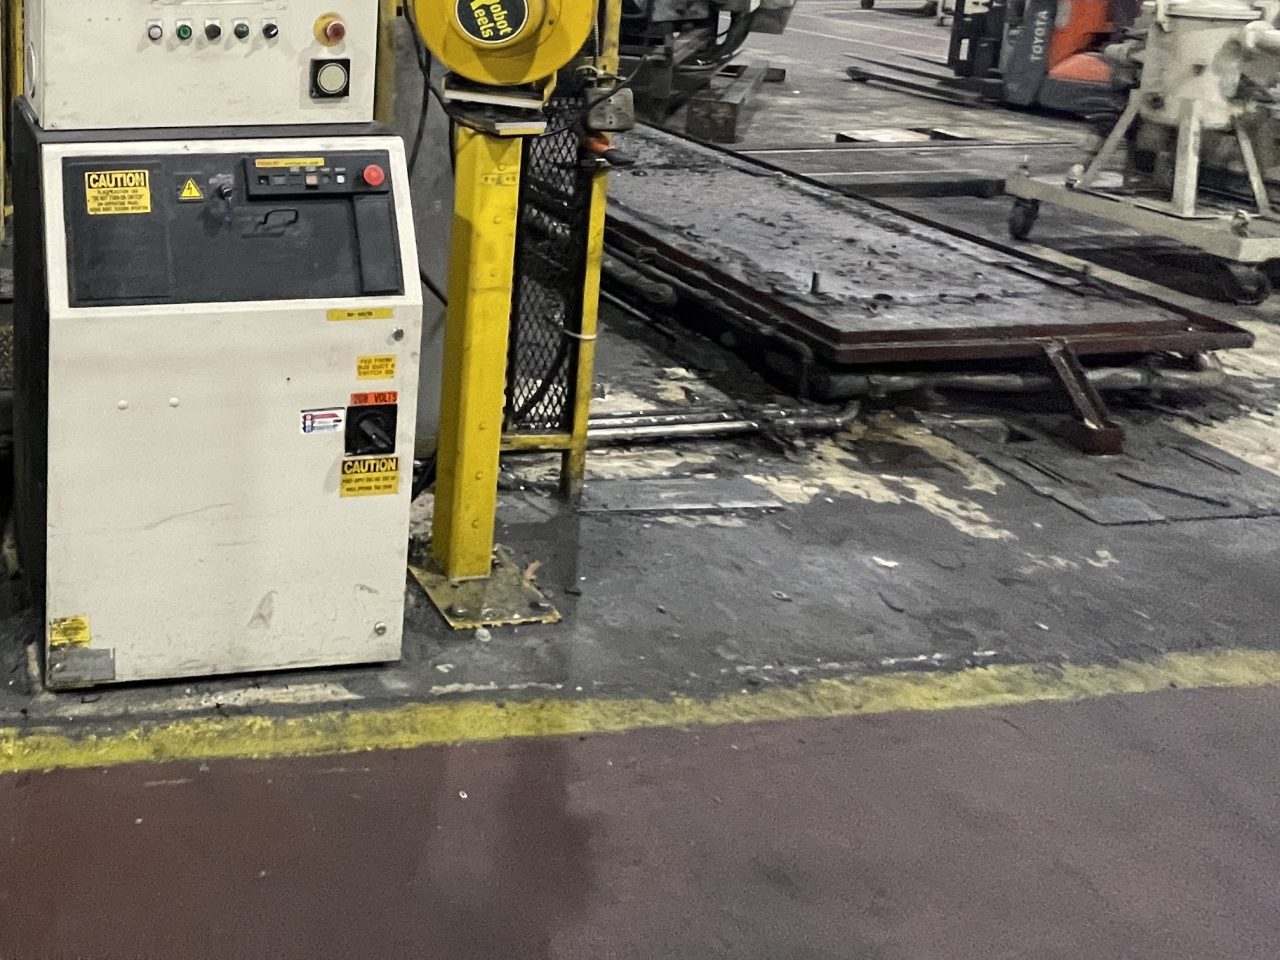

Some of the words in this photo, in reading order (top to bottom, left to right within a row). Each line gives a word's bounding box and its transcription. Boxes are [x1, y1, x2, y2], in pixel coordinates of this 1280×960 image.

[1030, 10, 1049, 61] TOYOTA
[89, 172, 145, 188] CAUTION
[374, 392, 397, 403] VOLTS
[343, 459, 397, 474] CAUTION
